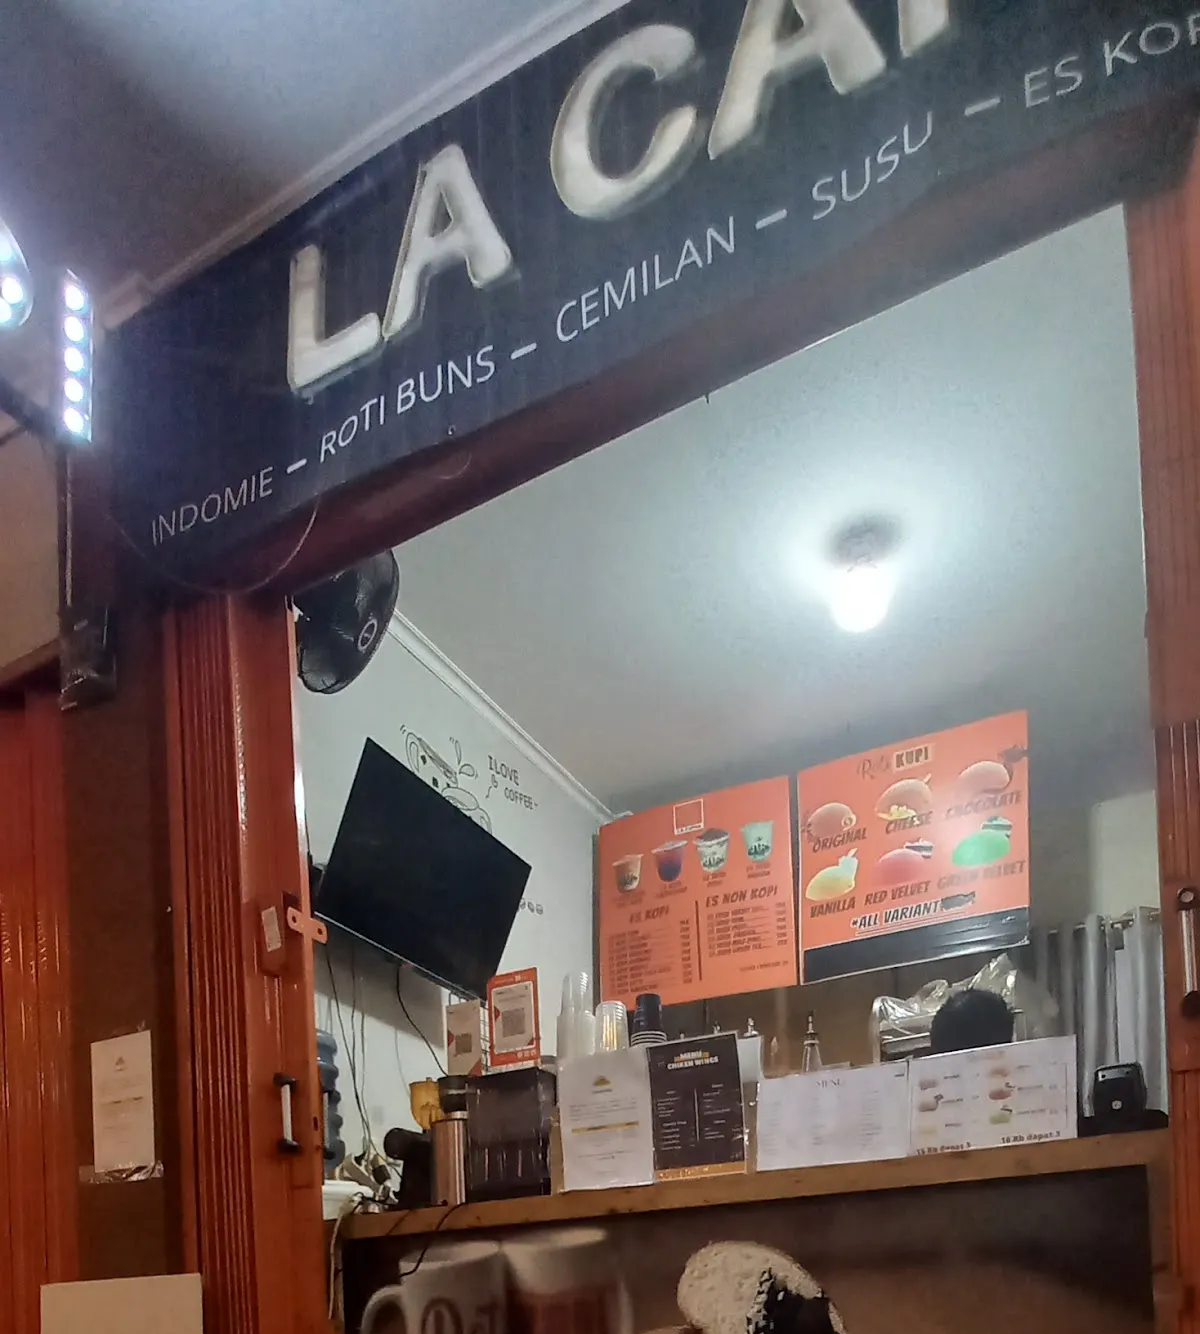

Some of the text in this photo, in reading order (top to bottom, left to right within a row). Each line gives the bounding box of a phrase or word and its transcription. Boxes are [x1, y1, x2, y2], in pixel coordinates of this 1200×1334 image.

[287, 141, 516, 393] LA
[152, 466, 274, 546] INDOMIE
[320, 395, 386, 463] ROTI
[396, 345, 496, 415] BUNS
[556, 215, 735, 344] CEMILAN
[811, 110, 933, 221] SUSU
[1023, 55, 1084, 109] ES
[894, 745, 930, 769] KUPI
[885, 810, 934, 835] CHEESE
[812, 827, 868, 853] ORIGINAL
[722, 889, 747, 905] NON
[750, 884, 778, 901] KOPI
[863, 880, 931, 908] RED VELVET
[809, 896, 856, 919] VANILLA
[883, 899, 942, 924] VARIANT
